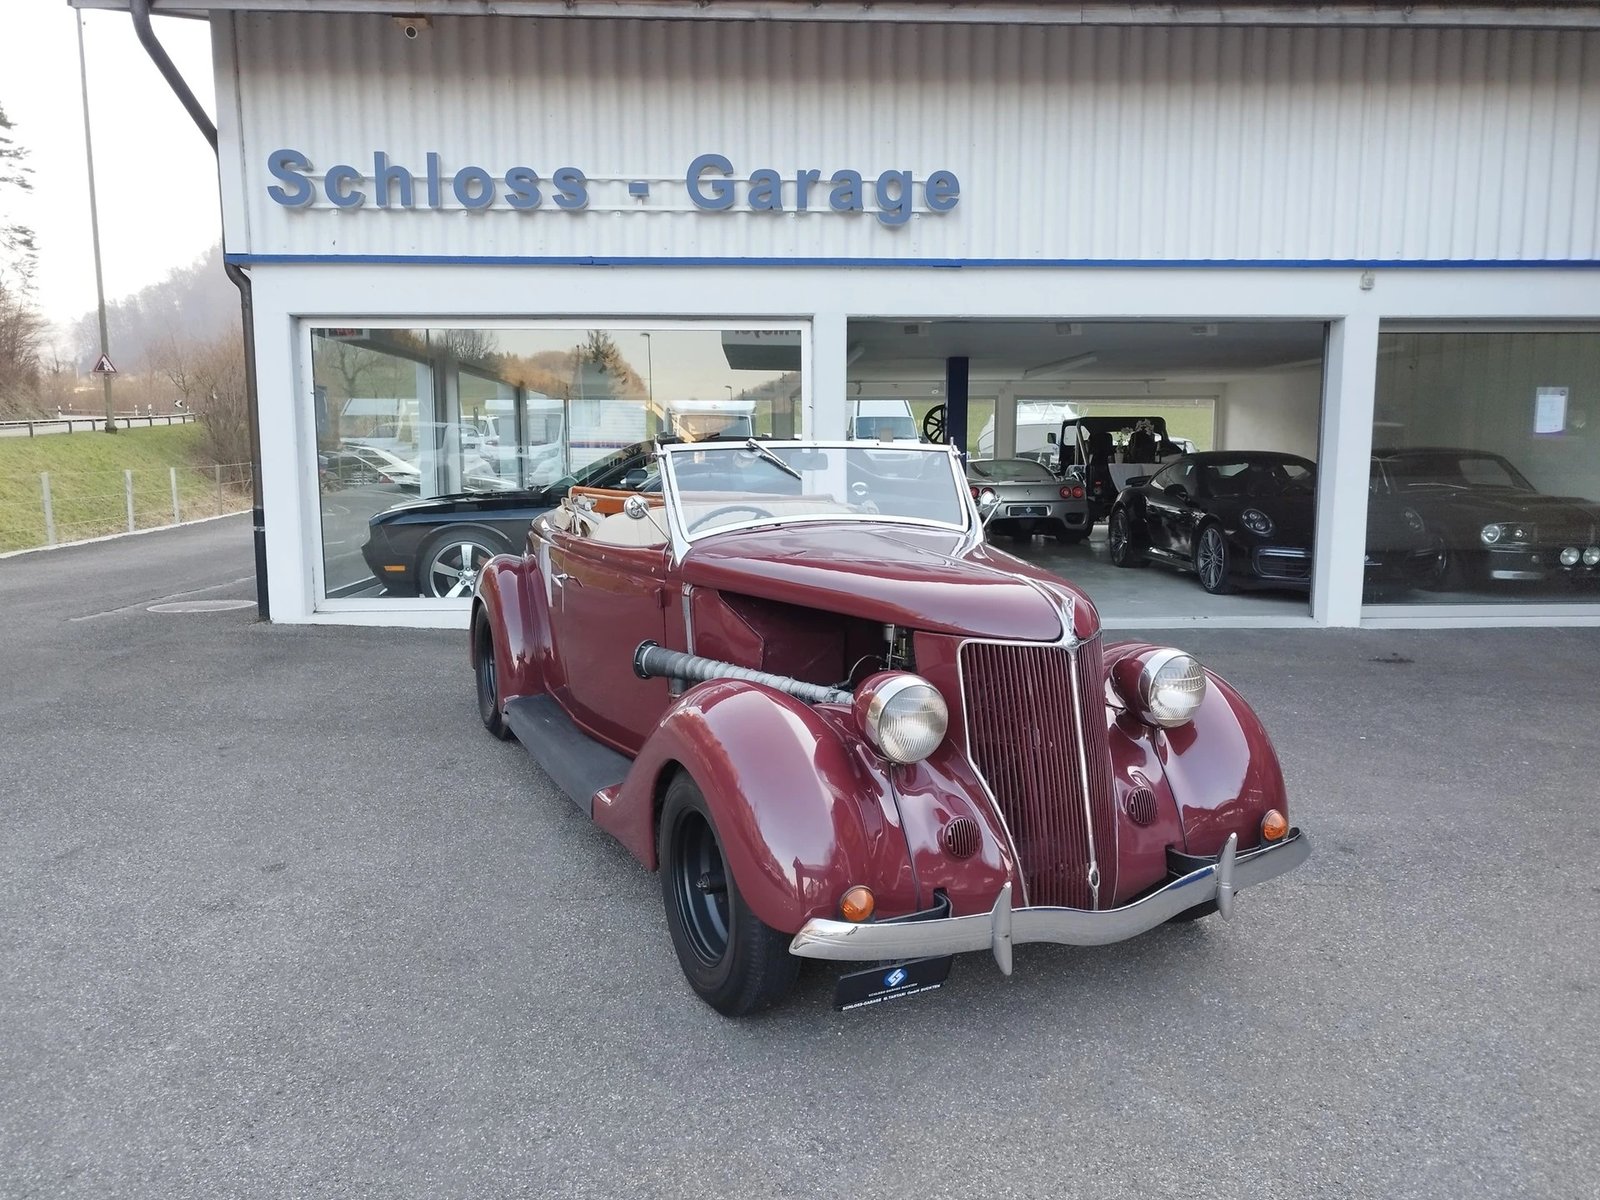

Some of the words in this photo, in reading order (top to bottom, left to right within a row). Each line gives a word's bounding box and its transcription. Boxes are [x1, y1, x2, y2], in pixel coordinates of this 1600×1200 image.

[267, 148, 590, 209] Schloss
[628, 182, 649, 197] -
[686, 153, 961, 226] Garage
